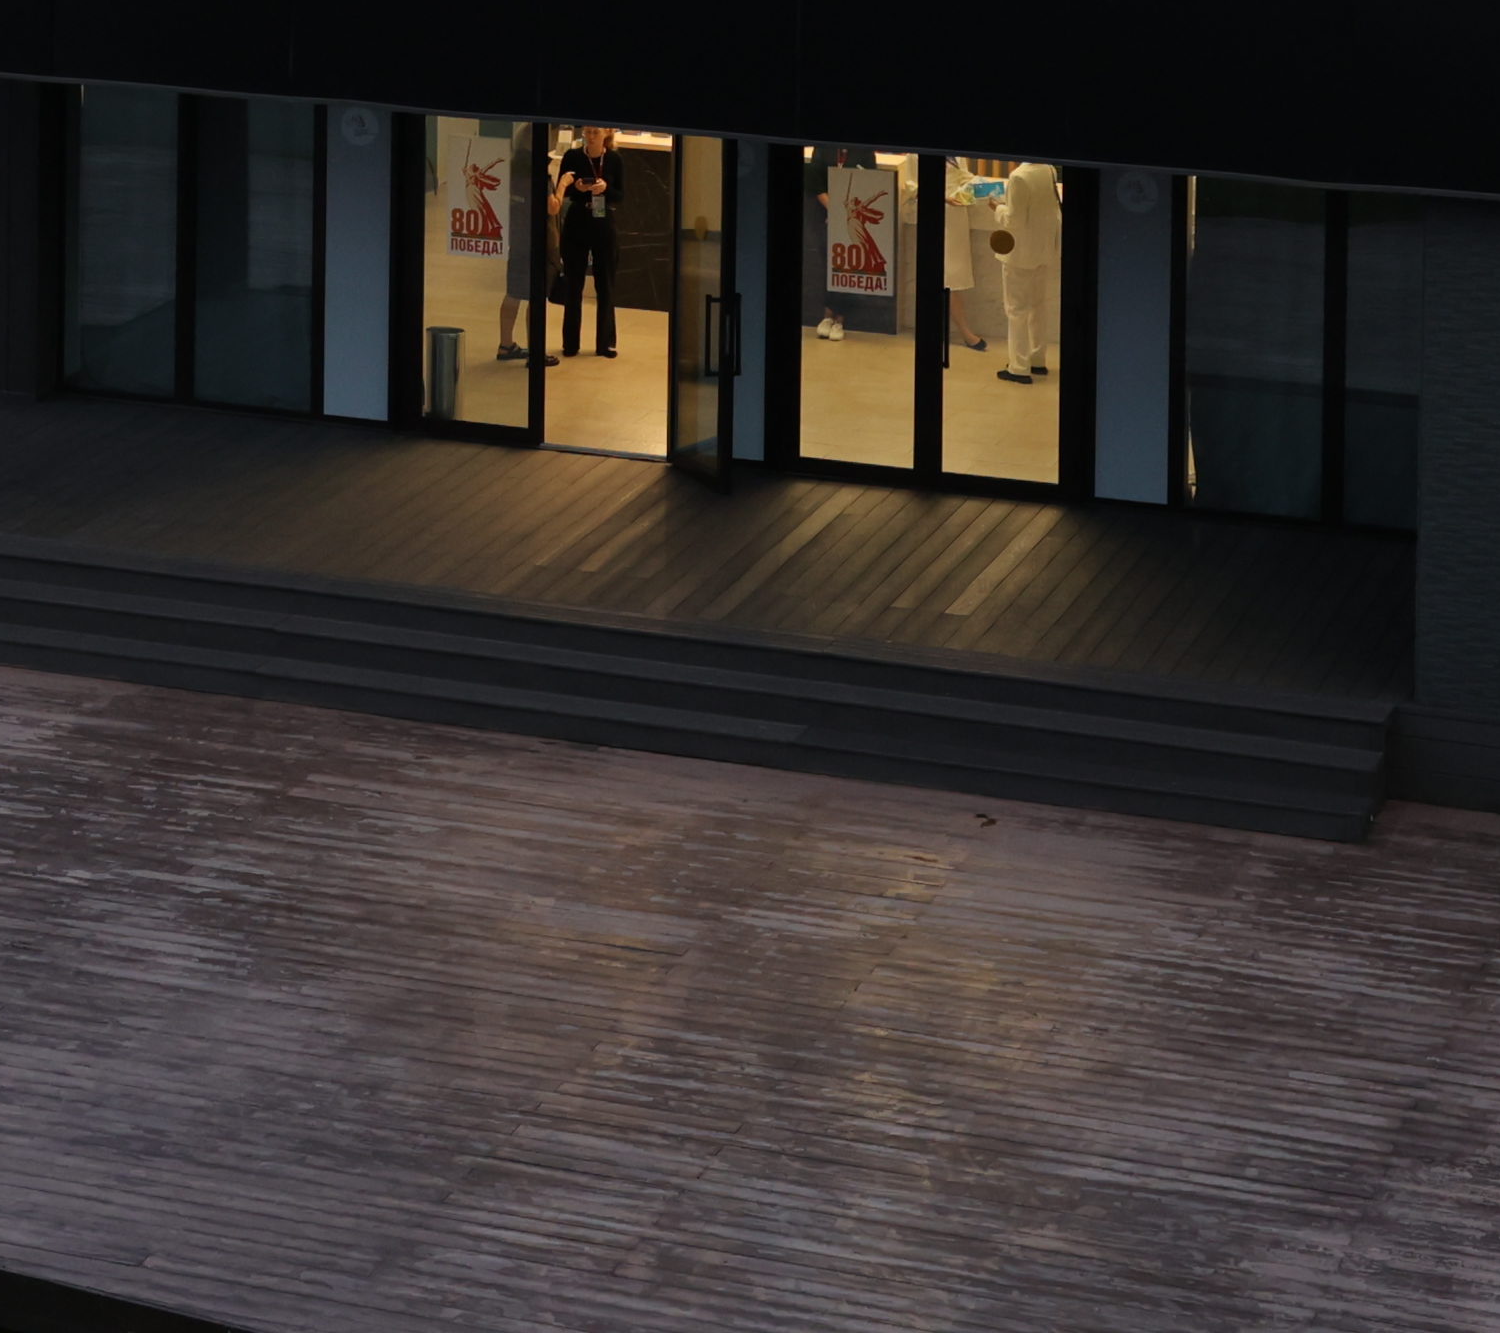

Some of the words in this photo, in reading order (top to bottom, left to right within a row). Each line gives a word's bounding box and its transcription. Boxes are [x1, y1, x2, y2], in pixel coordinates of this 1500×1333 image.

[451, 208, 480, 235] 80
[451, 237, 503, 255] ПОБЕДА!
[831, 242, 862, 270] 80
[831, 273, 888, 292] ПОБЕДА!
